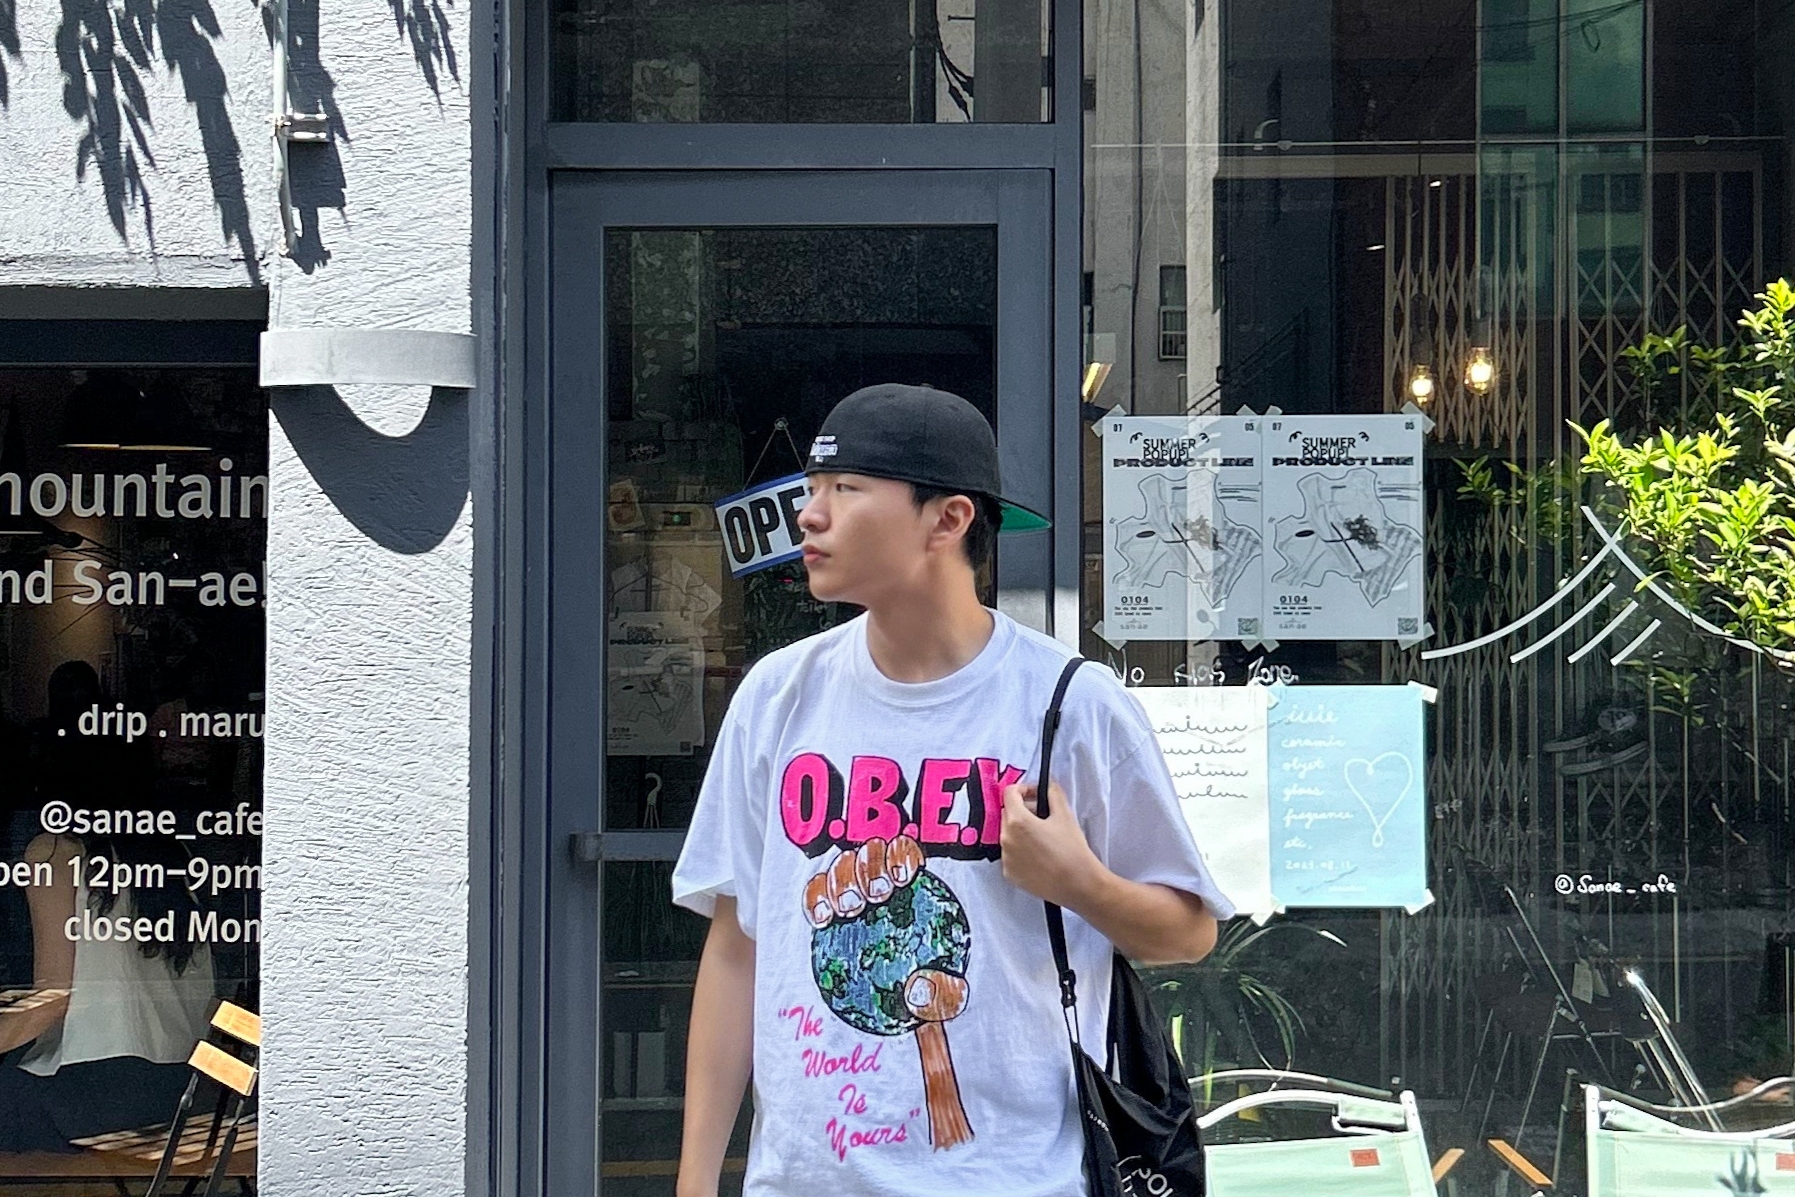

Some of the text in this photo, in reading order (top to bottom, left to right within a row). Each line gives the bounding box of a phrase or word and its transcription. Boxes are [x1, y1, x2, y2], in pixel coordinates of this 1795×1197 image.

[1142, 437, 1196, 450] SUMMER
[1301, 436, 1356, 449] SUMMER
[1113, 456, 1254, 467] PRODUCT LINE
[1272, 455, 1414, 466] PRODUCT LINE
[1120, 595, 1150, 606] 0104
[1279, 594, 1308, 605] 0104
[78, 703, 265, 743] drip maru
[40, 800, 263, 841] @sanae_cafe
[64, 908, 261, 943] closed Mon
[801, 1042, 884, 1079] World
[838, 1083, 868, 1116] Is
